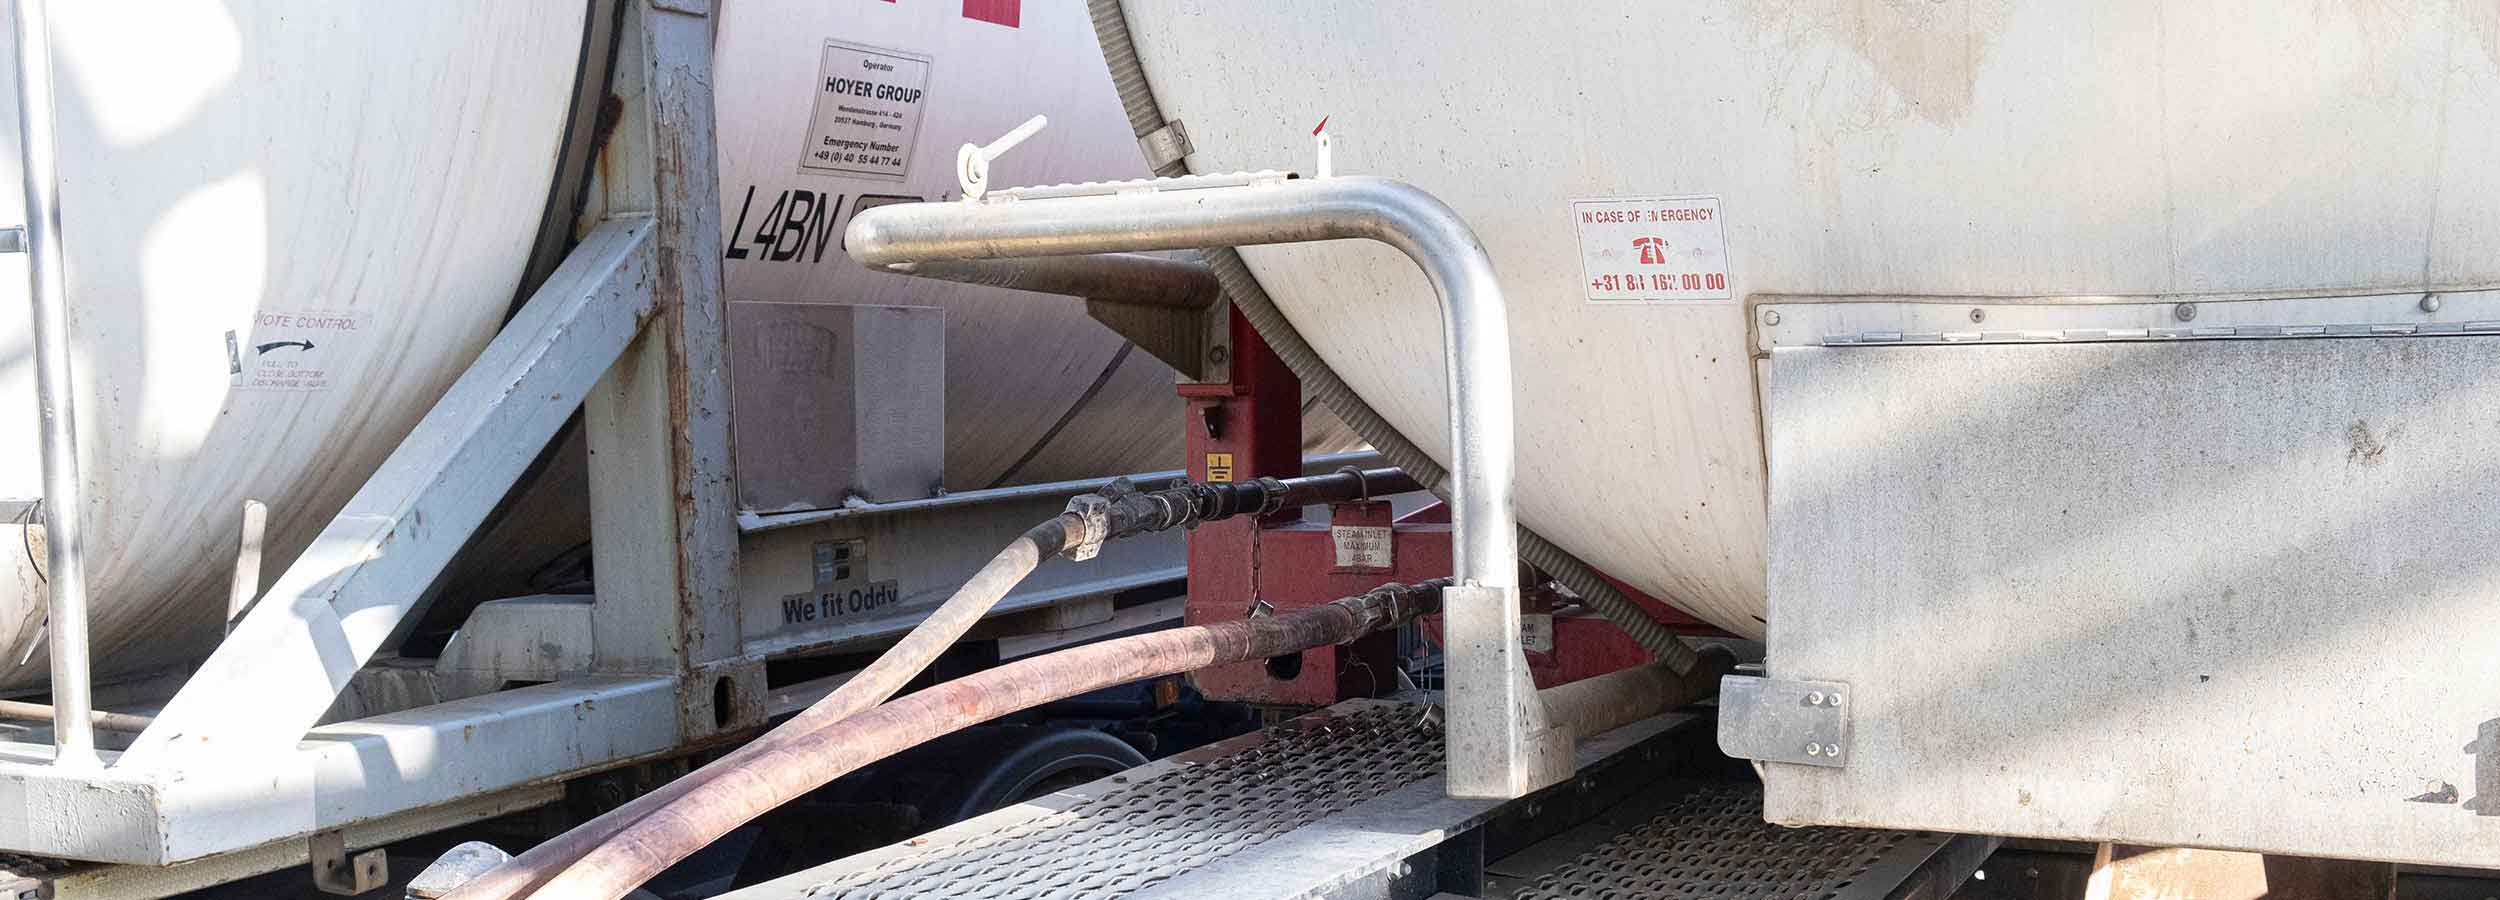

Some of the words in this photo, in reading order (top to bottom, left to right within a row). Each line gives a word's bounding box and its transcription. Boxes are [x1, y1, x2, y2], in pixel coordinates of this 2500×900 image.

[863, 59, 894, 73] Operator
[825, 76, 873, 98] HOYER
[876, 83, 922, 104] GROUP
[824, 135, 869, 151] Emergency
[869, 141, 900, 153] Number
[814, 150, 829, 161] +49
[830, 151, 843, 163] (0)
[843, 152, 855, 163] 40
[858, 153, 868, 164] 55
[869, 155, 880, 165] 44
[880, 156, 891, 166] 77
[891, 157, 902, 167] 44
[725, 185, 844, 264] L4BN
[1582, 211, 1593, 224] IN
[1596, 210, 1625, 224] CASE
[1627, 209, 1641, 223] OF
[1592, 273, 1620, 291] +31
[1682, 272, 1701, 291] 00
[1705, 272, 1726, 291] 00
[296, 315, 358, 331] CONTROL
[1337, 529, 1364, 539] STEAM
[783, 597, 816, 625] We
[822, 591, 844, 619] fit
